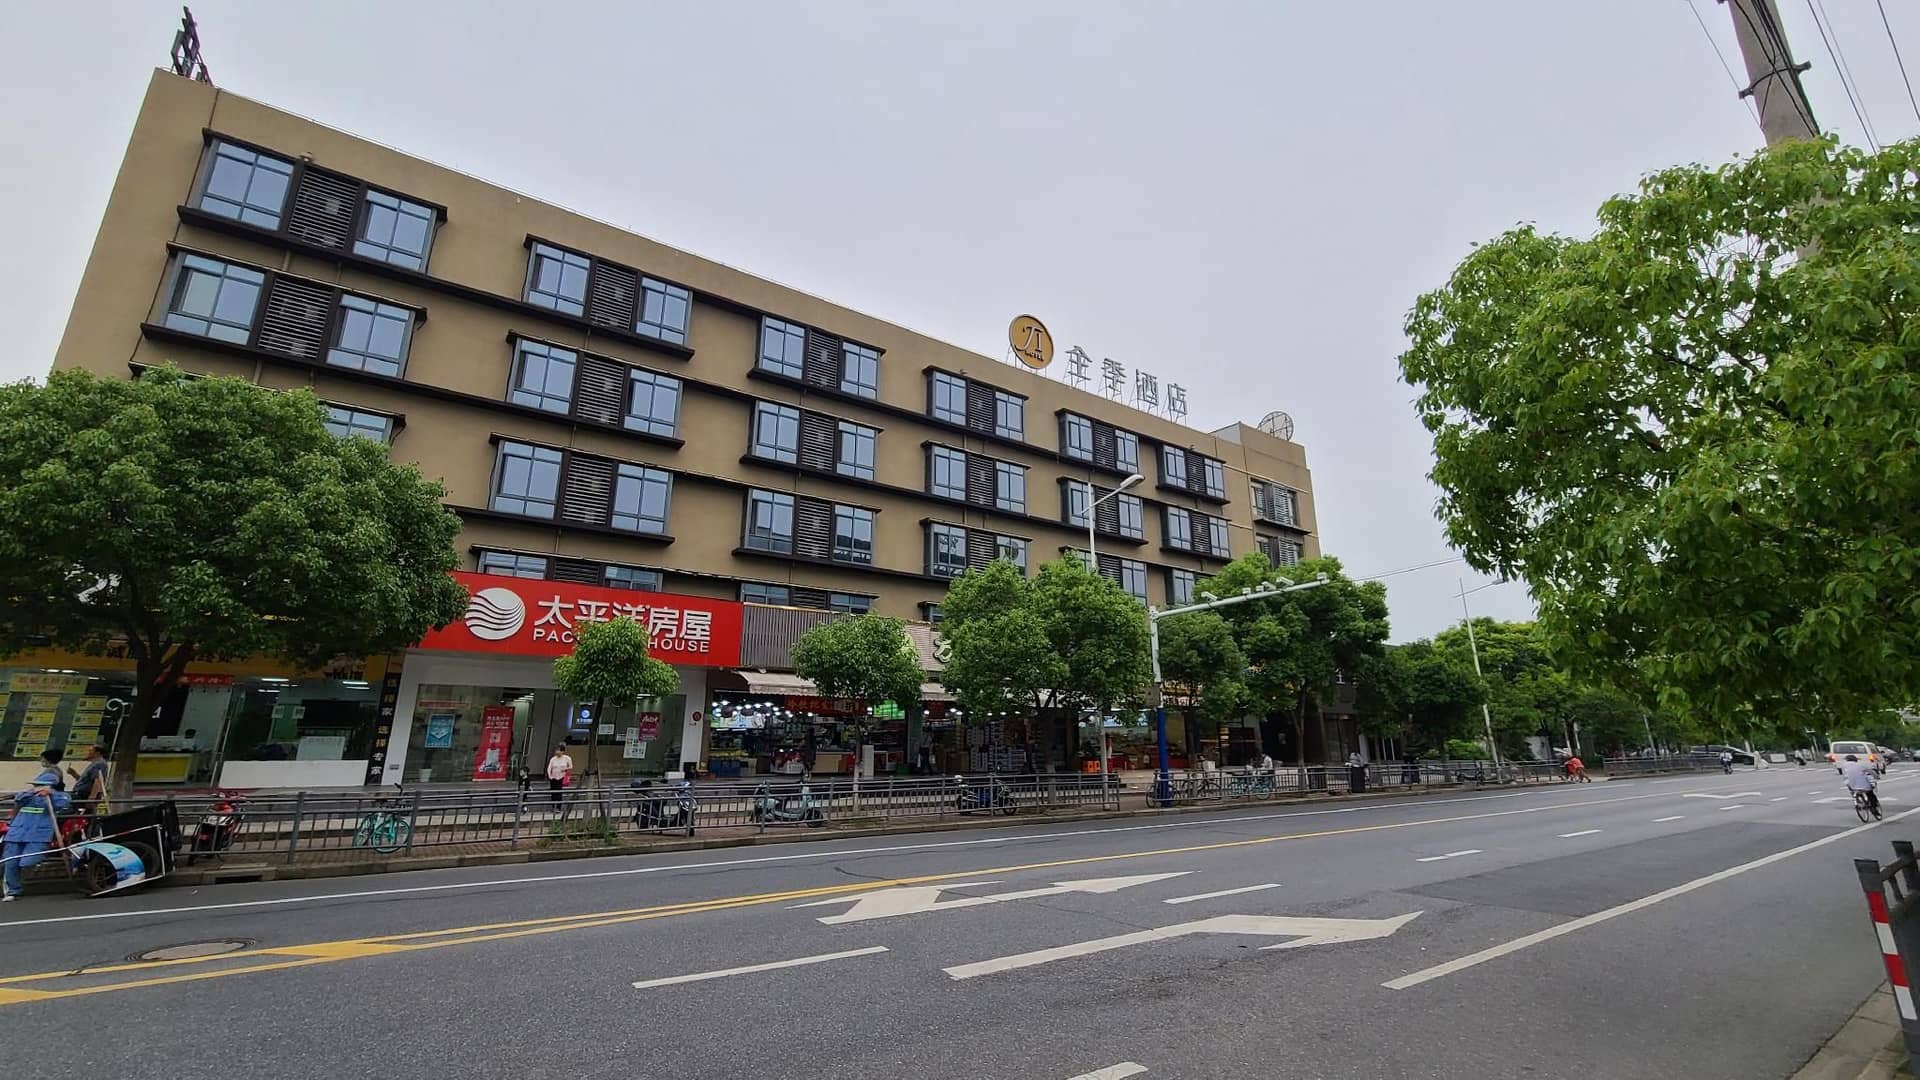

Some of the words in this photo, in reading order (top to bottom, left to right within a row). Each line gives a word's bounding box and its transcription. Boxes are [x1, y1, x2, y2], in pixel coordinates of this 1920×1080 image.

[1064, 345, 1188, 415] 全季酒店
[533, 595, 712, 641] 太平洋房屋
[647, 637, 710, 653] HOUSE
